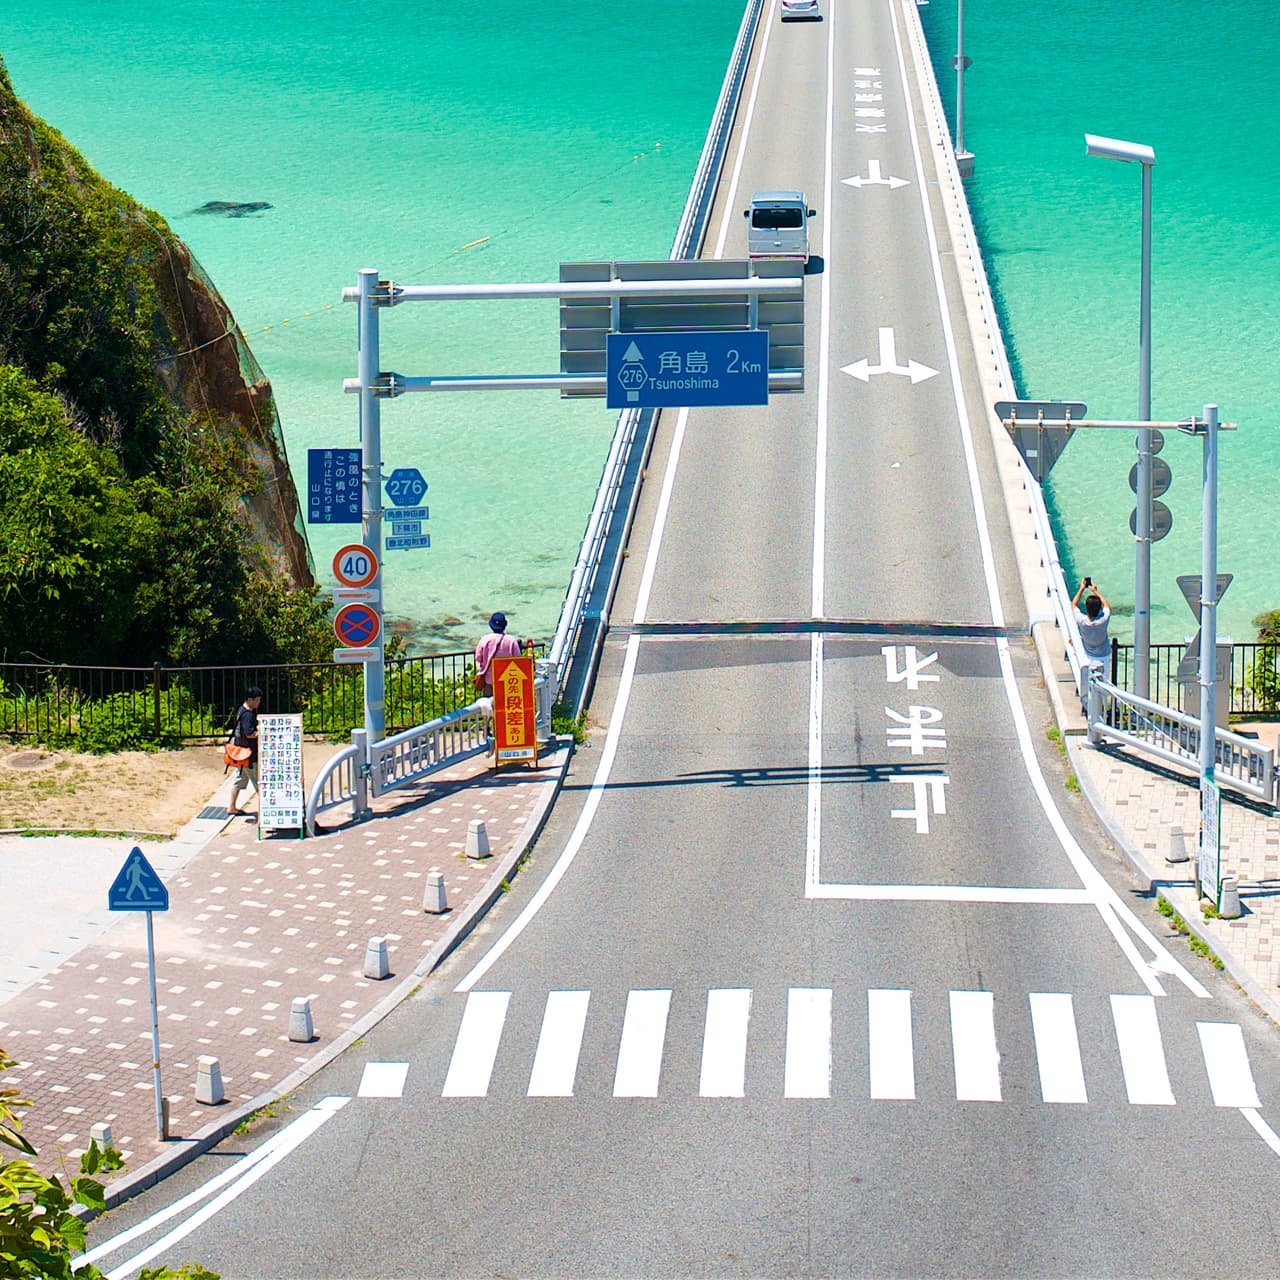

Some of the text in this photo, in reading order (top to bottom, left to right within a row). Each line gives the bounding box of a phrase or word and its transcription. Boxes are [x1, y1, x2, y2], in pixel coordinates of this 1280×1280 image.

[658, 350, 709, 375] 角島
[623, 369, 643, 384] 276
[649, 377, 719, 390] Tsunoshima
[390, 480, 422, 495] 276
[343, 556, 367, 576] 40
[506, 668, 523, 743] この先段差あり
[882, 645, 950, 834] 止まれ
